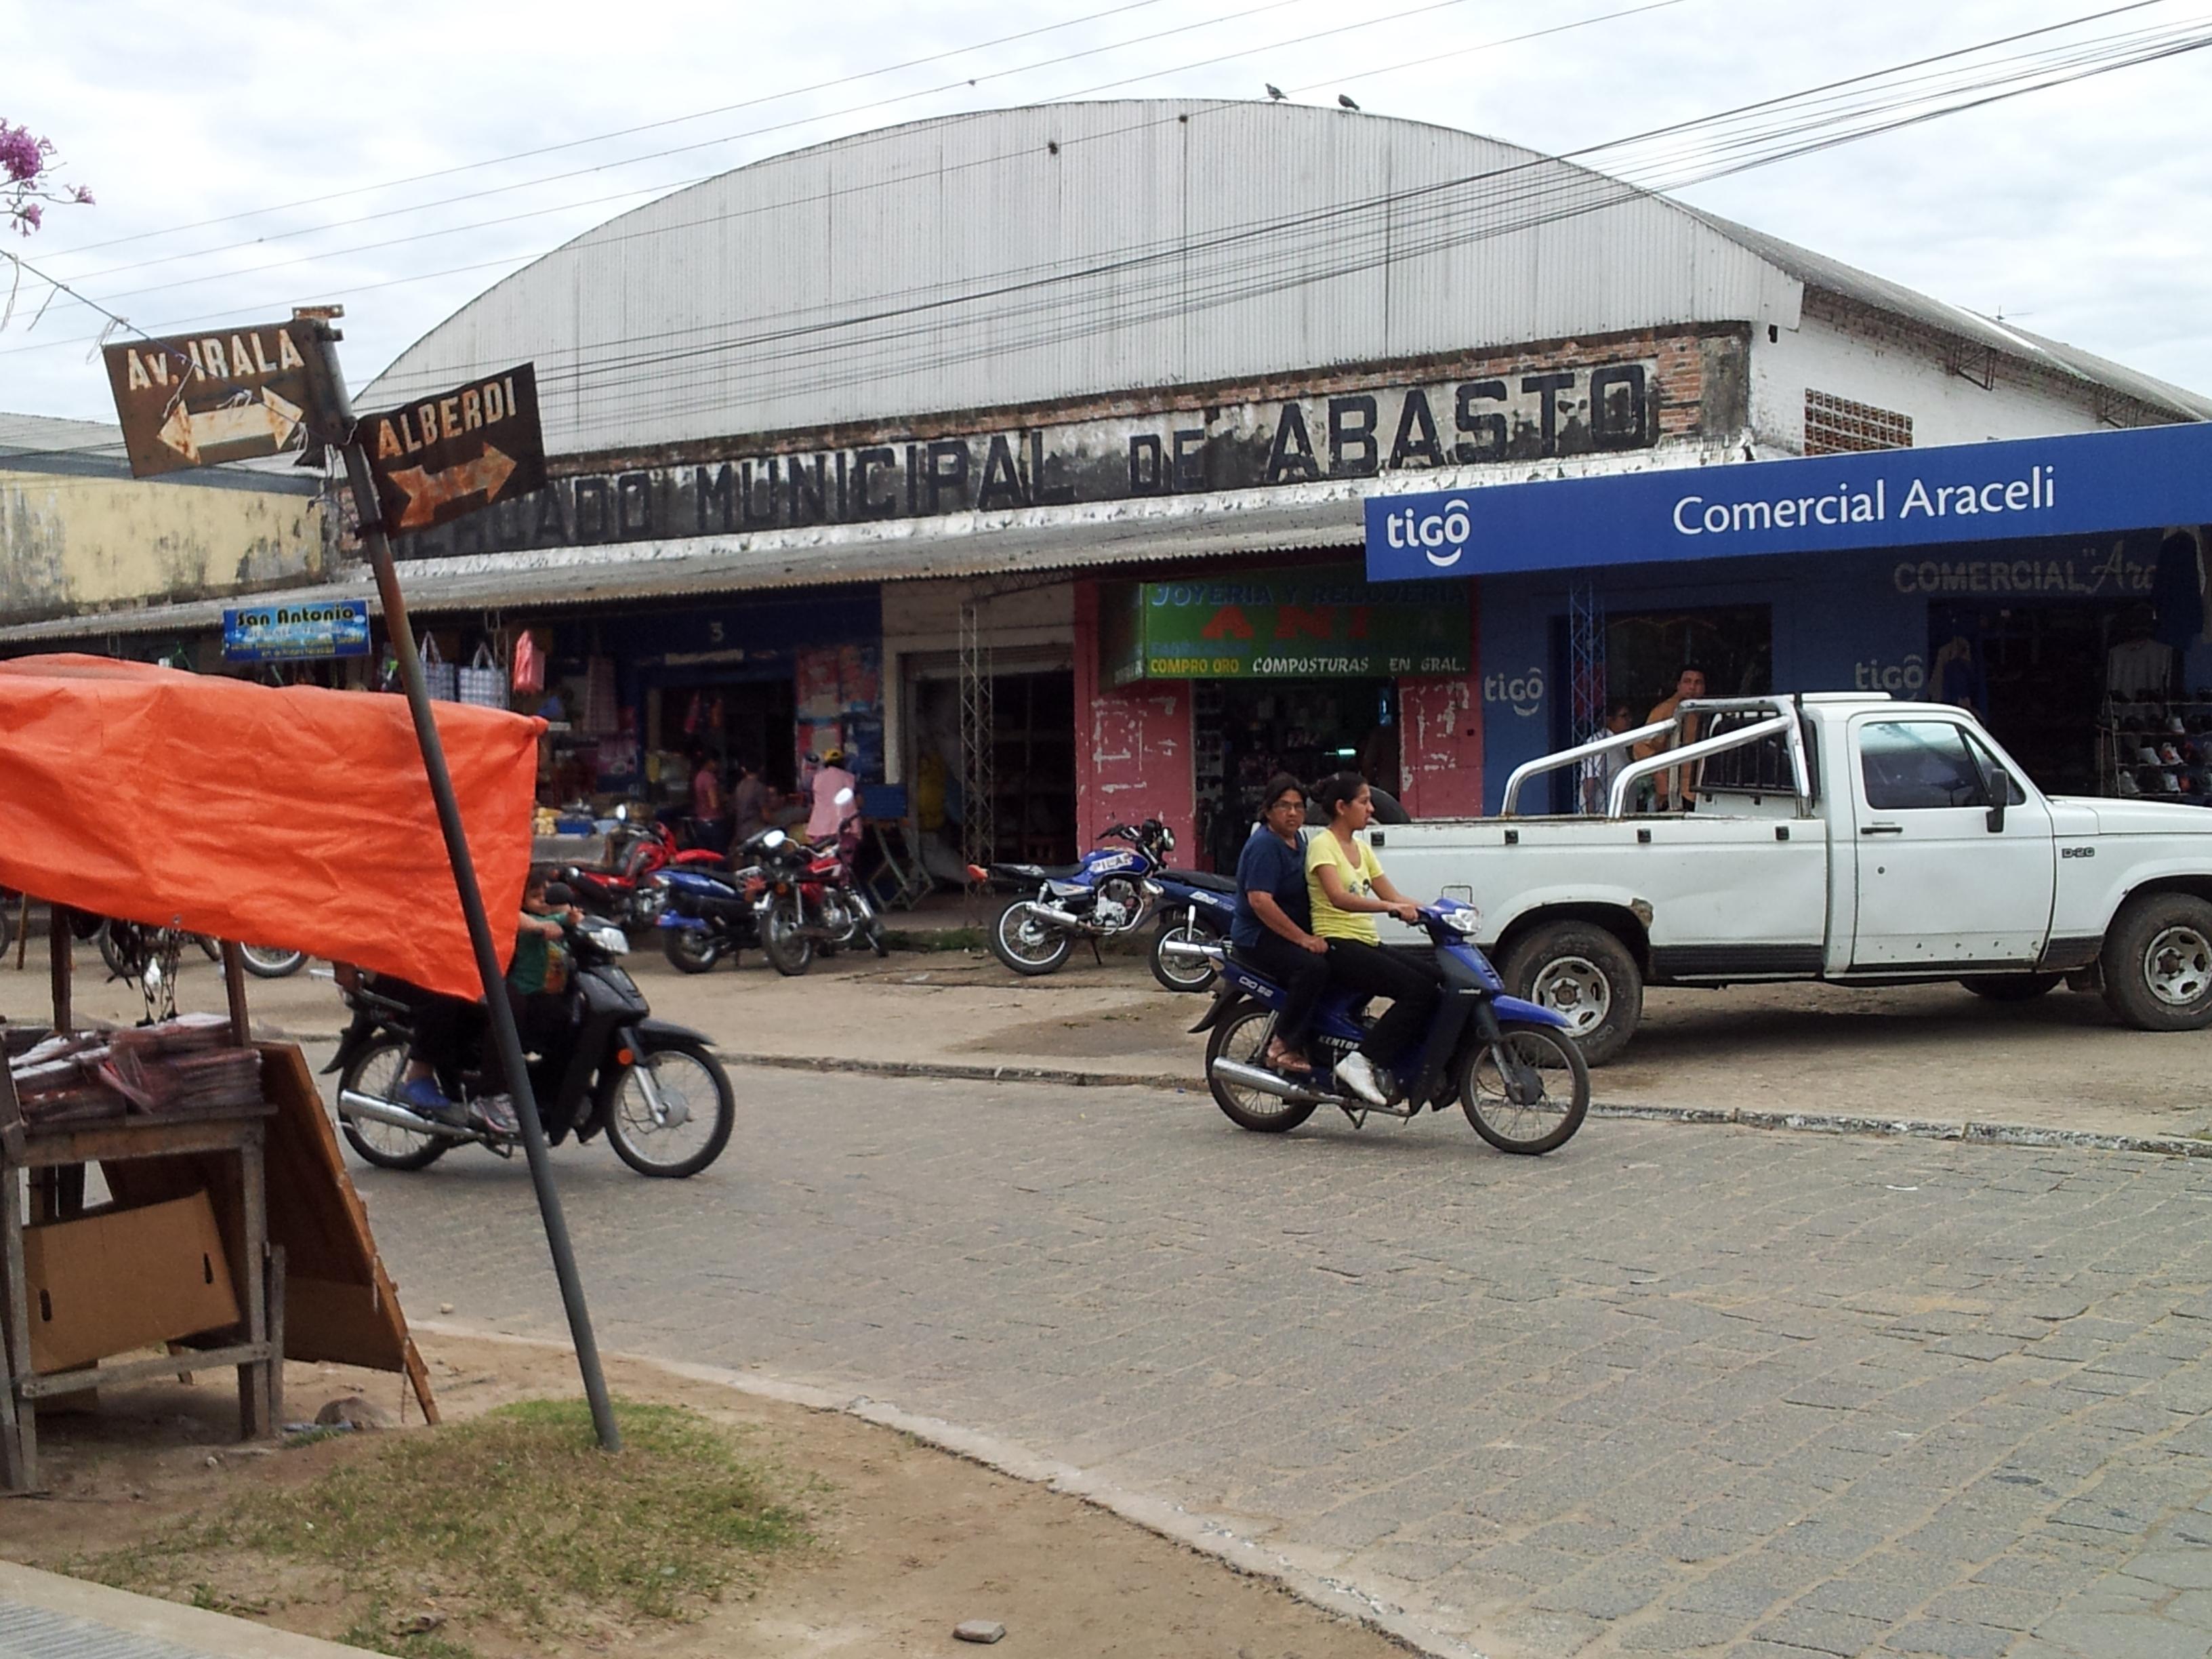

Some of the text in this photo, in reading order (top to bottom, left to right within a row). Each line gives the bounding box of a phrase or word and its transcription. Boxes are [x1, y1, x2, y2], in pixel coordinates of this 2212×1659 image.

[188, 328, 305, 382] IRALA
[377, 376, 517, 460] ALBERDI
[695, 430, 1076, 531] MUNICIPAL
[1129, 428, 1208, 494] DE
[1265, 364, 1647, 483] ABASTO
[1673, 465, 2055, 535] Comercial Araceli
[1893, 560, 2089, 593] COMERCIAL
[1151, 585, 1275, 607] JOYERIA
[237, 604, 354, 628] San Antonio
[1201, 605, 1373, 640] ANI
[1151, 658, 1208, 674] COMPRO
[1212, 658, 1240, 674] ORO
[1252, 656, 1370, 674] COMPOSTURAS
[1389, 656, 1411, 672] EN
[1420, 656, 1467, 672] GRAL.
